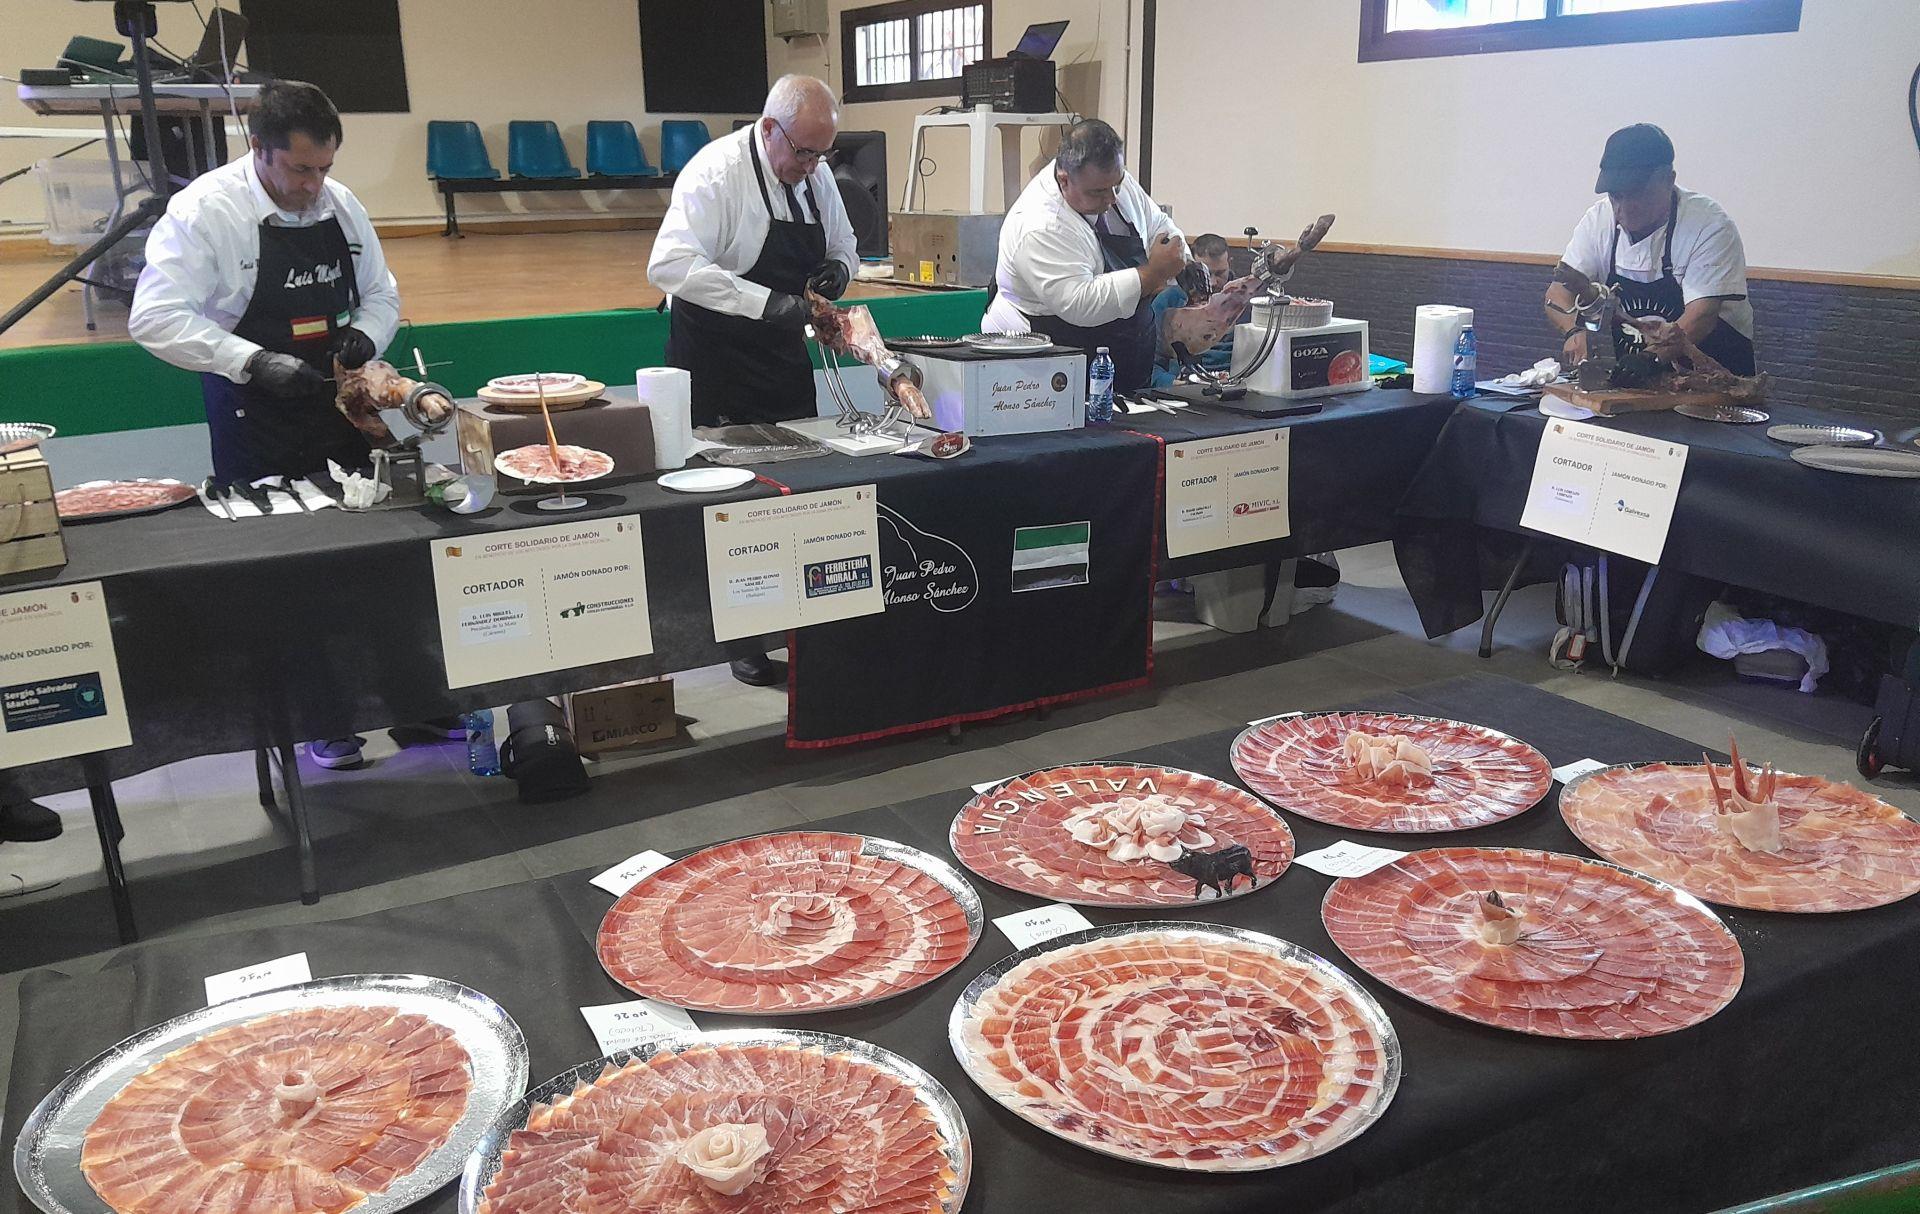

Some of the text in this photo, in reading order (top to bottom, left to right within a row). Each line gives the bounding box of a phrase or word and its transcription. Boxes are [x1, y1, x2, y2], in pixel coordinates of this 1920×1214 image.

[283, 268, 314, 289] Luis
[1293, 347, 1328, 358] GOZA
[991, 380, 1040, 396] Juan Pedro
[992, 397, 1057, 413] Alonso Sánchez
[1576, 431, 1594, 440] CORTE
[1595, 435, 1626, 448] SOLIDARIO
[1197, 447, 1213, 455] CORTE
[1214, 443, 1240, 453] SOLIDARIO
[1552, 456, 1593, 472] CORTADOR
[1234, 470, 1250, 478] JAMÓN
[1250, 467, 1269, 476] DONADO
[1611, 471, 1631, 481] JAMÓN
[1631, 475, 1655, 486] DONADO
[1181, 475, 1218, 488] CORTADOR
[747, 509, 770, 518] CORTE
[772, 504, 809, 515] SOLIDARIO
[819, 499, 842, 508] JAMÓN
[485, 542, 513, 552] CORTE
[515, 536, 559, 549] SOLIDARIO
[560, 534, 572, 542] DE
[573, 531, 600, 541] JAMÓN
[803, 535, 826, 545] JAMÓN
[826, 532, 852, 541] DONADO
[728, 542, 780, 557] CORTADOR
[554, 570, 580, 581] JAMÓN
[581, 566, 613, 577] DONADO
[825, 557, 868, 574] FERRETERÍA
[884, 565, 917, 588] Juan
[919, 559, 957, 578] Pedro
[825, 570, 858, 586] MORALA
[462, 578, 525, 596] CORTADOR
[923, 582, 969, 600] Sánchez
[0, 602, 48, 617] E JAMÓN
[586, 597, 634, 609] CONSTRUCCIONES
[26, 644, 69, 658] DONADO
[71, 641, 94, 651] POR:
[4, 682, 78, 700] Sergio Salvador
[606, 722, 658, 740] MIARCO
[973, 777, 1158, 835] VALENCIA
